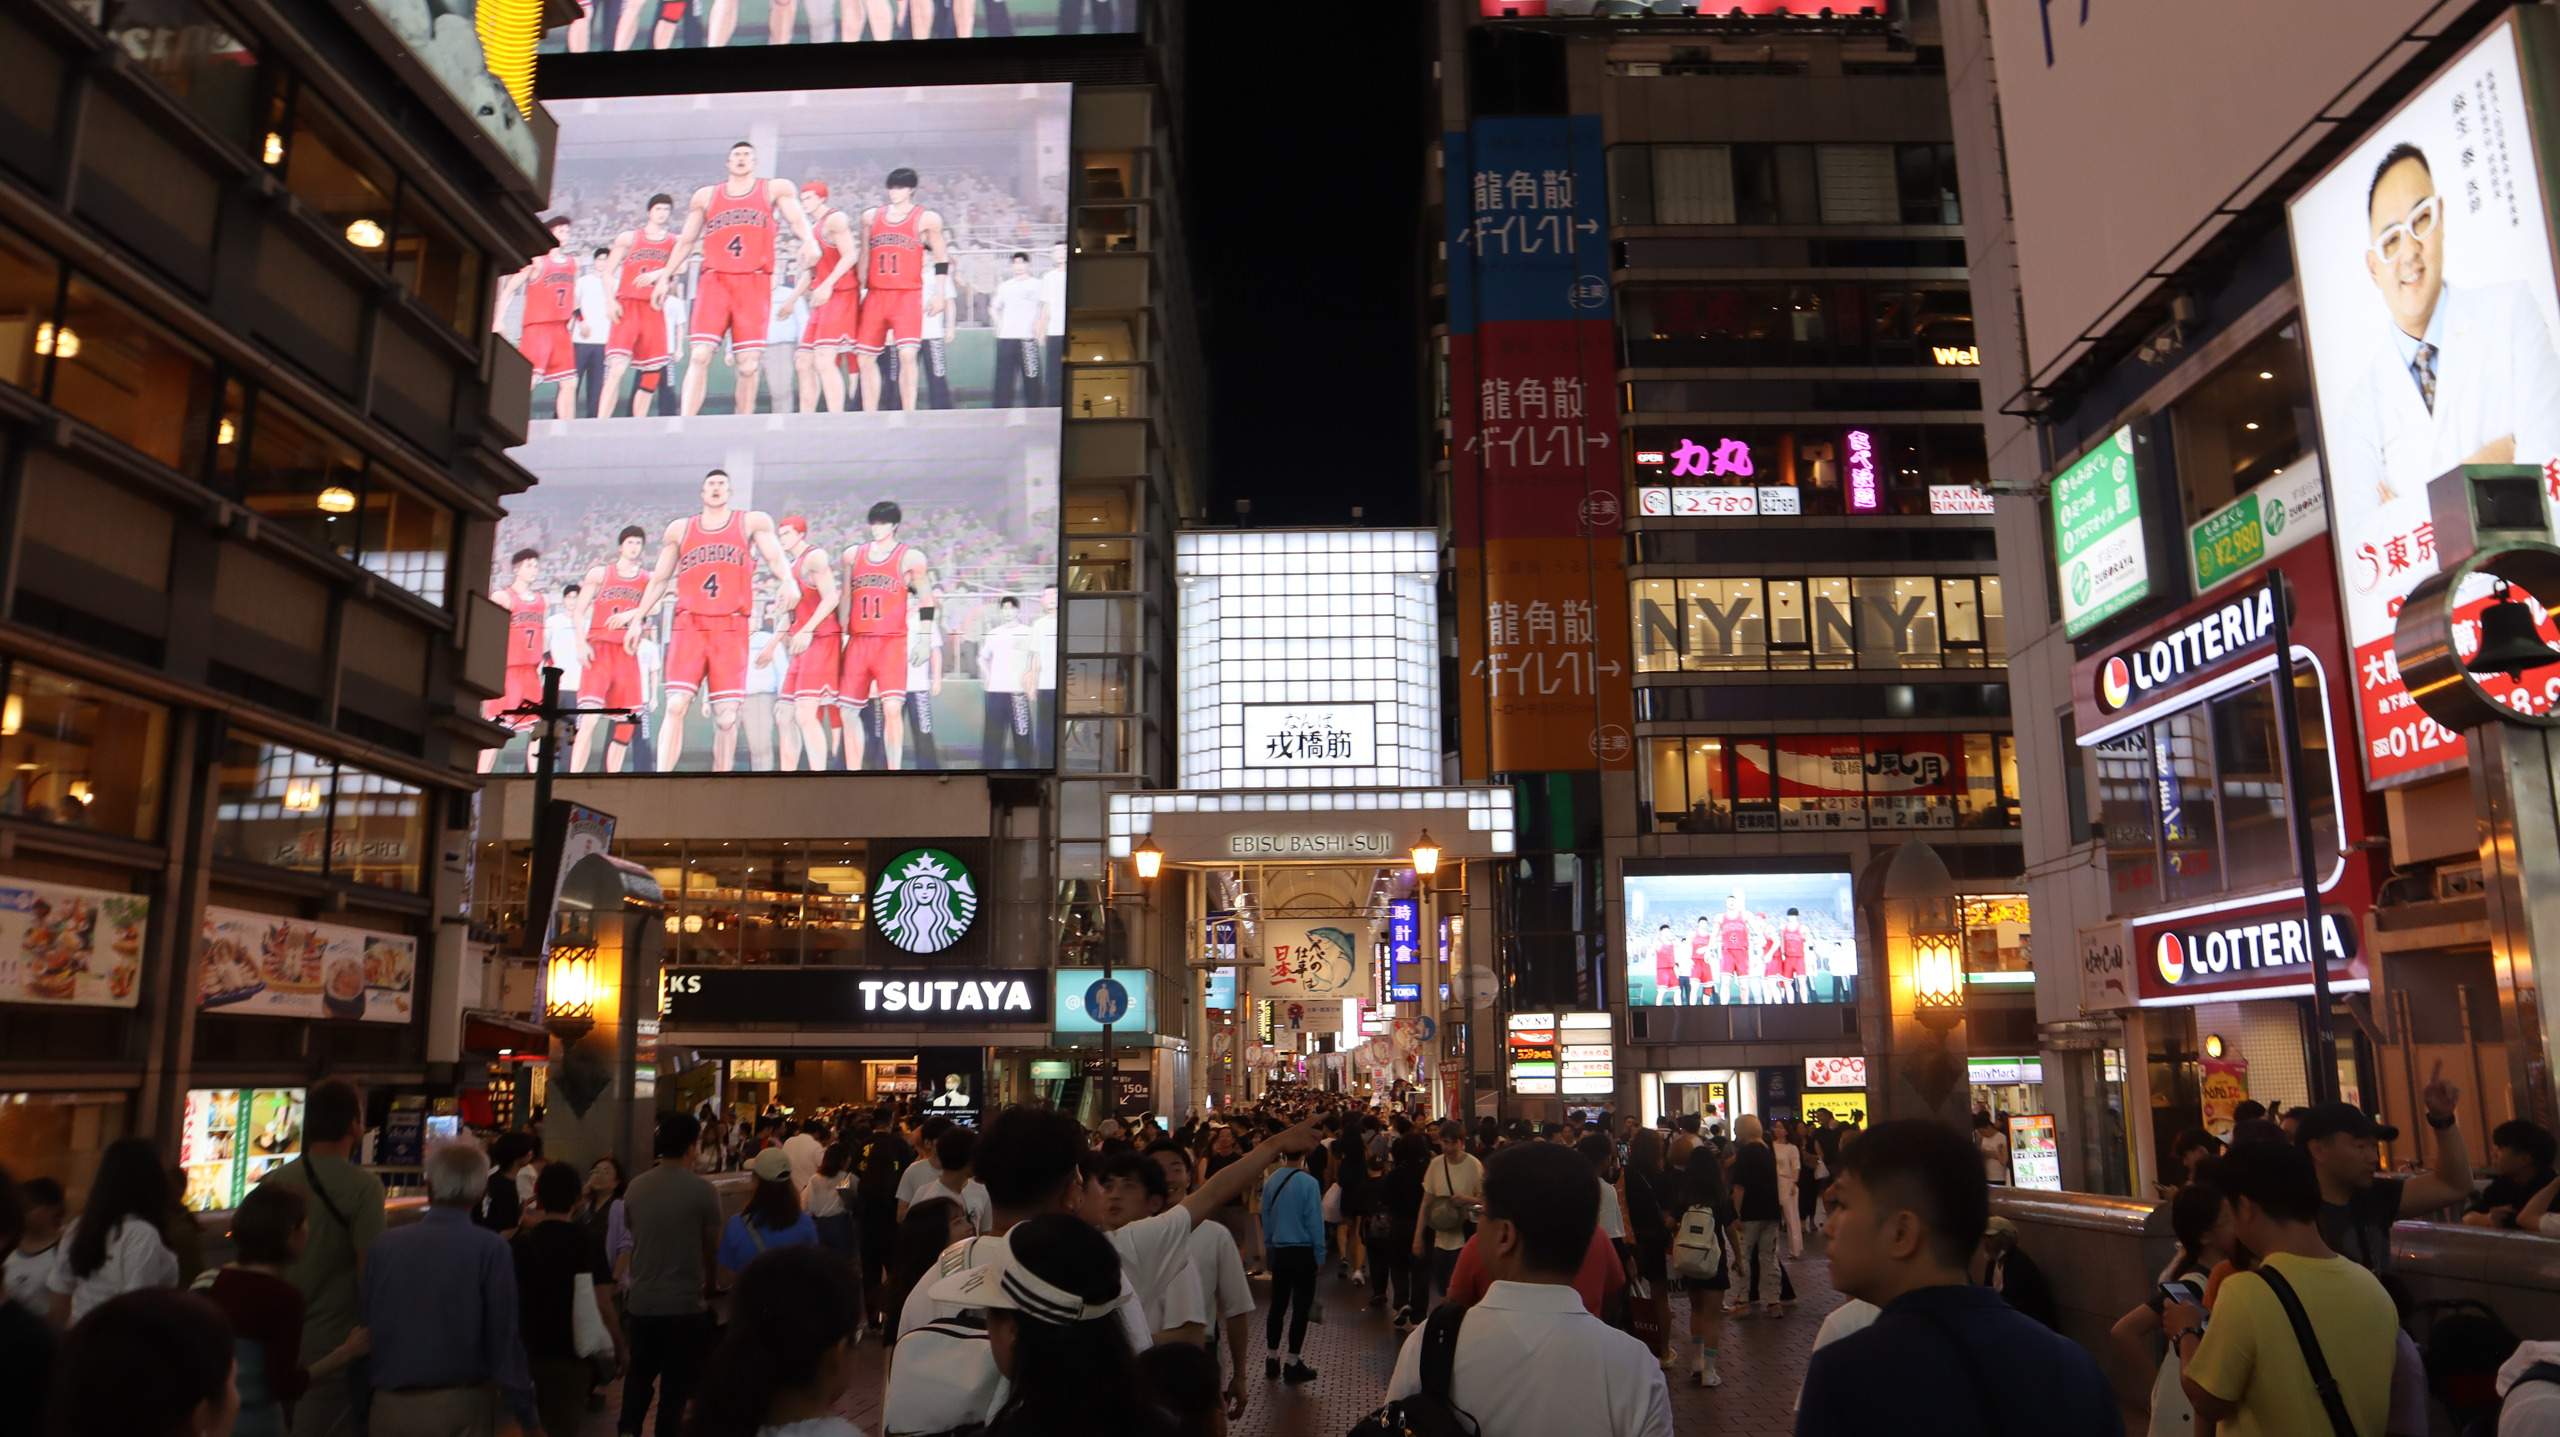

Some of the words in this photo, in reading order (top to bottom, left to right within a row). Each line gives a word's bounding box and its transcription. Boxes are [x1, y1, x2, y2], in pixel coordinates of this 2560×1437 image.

[1474, 169, 1579, 212] 龍角散
[727, 234, 744, 258] 4
[877, 253, 898, 275] 11
[556, 289, 566, 307] 7
[1481, 376, 1589, 422] 龍角散
[1670, 438, 1754, 476] 力丸
[1931, 488, 1992, 501] YAKIN
[2384, 522, 2435, 577] 東京
[703, 573, 720, 598] 4
[860, 596, 881, 620] 11
[1488, 599, 1598, 646] 龍角散
[526, 629, 534, 649] 7
[1640, 597, 1753, 656] NY
[1814, 596, 1926, 654] NY
[2133, 587, 2275, 689] LOTTERIA
[1266, 730, 1352, 759] 戎橋筋
[1866, 747, 1943, 786] 風月
[1232, 836, 1284, 852] EBISU
[1395, 904, 1413, 962] 時計倉
[2188, 914, 2346, 974] LOTTERIA
[1270, 945, 1297, 985] 日本一
[859, 981, 1032, 1011] TSUTAYA
[1392, 987, 1417, 997] TOKIA
